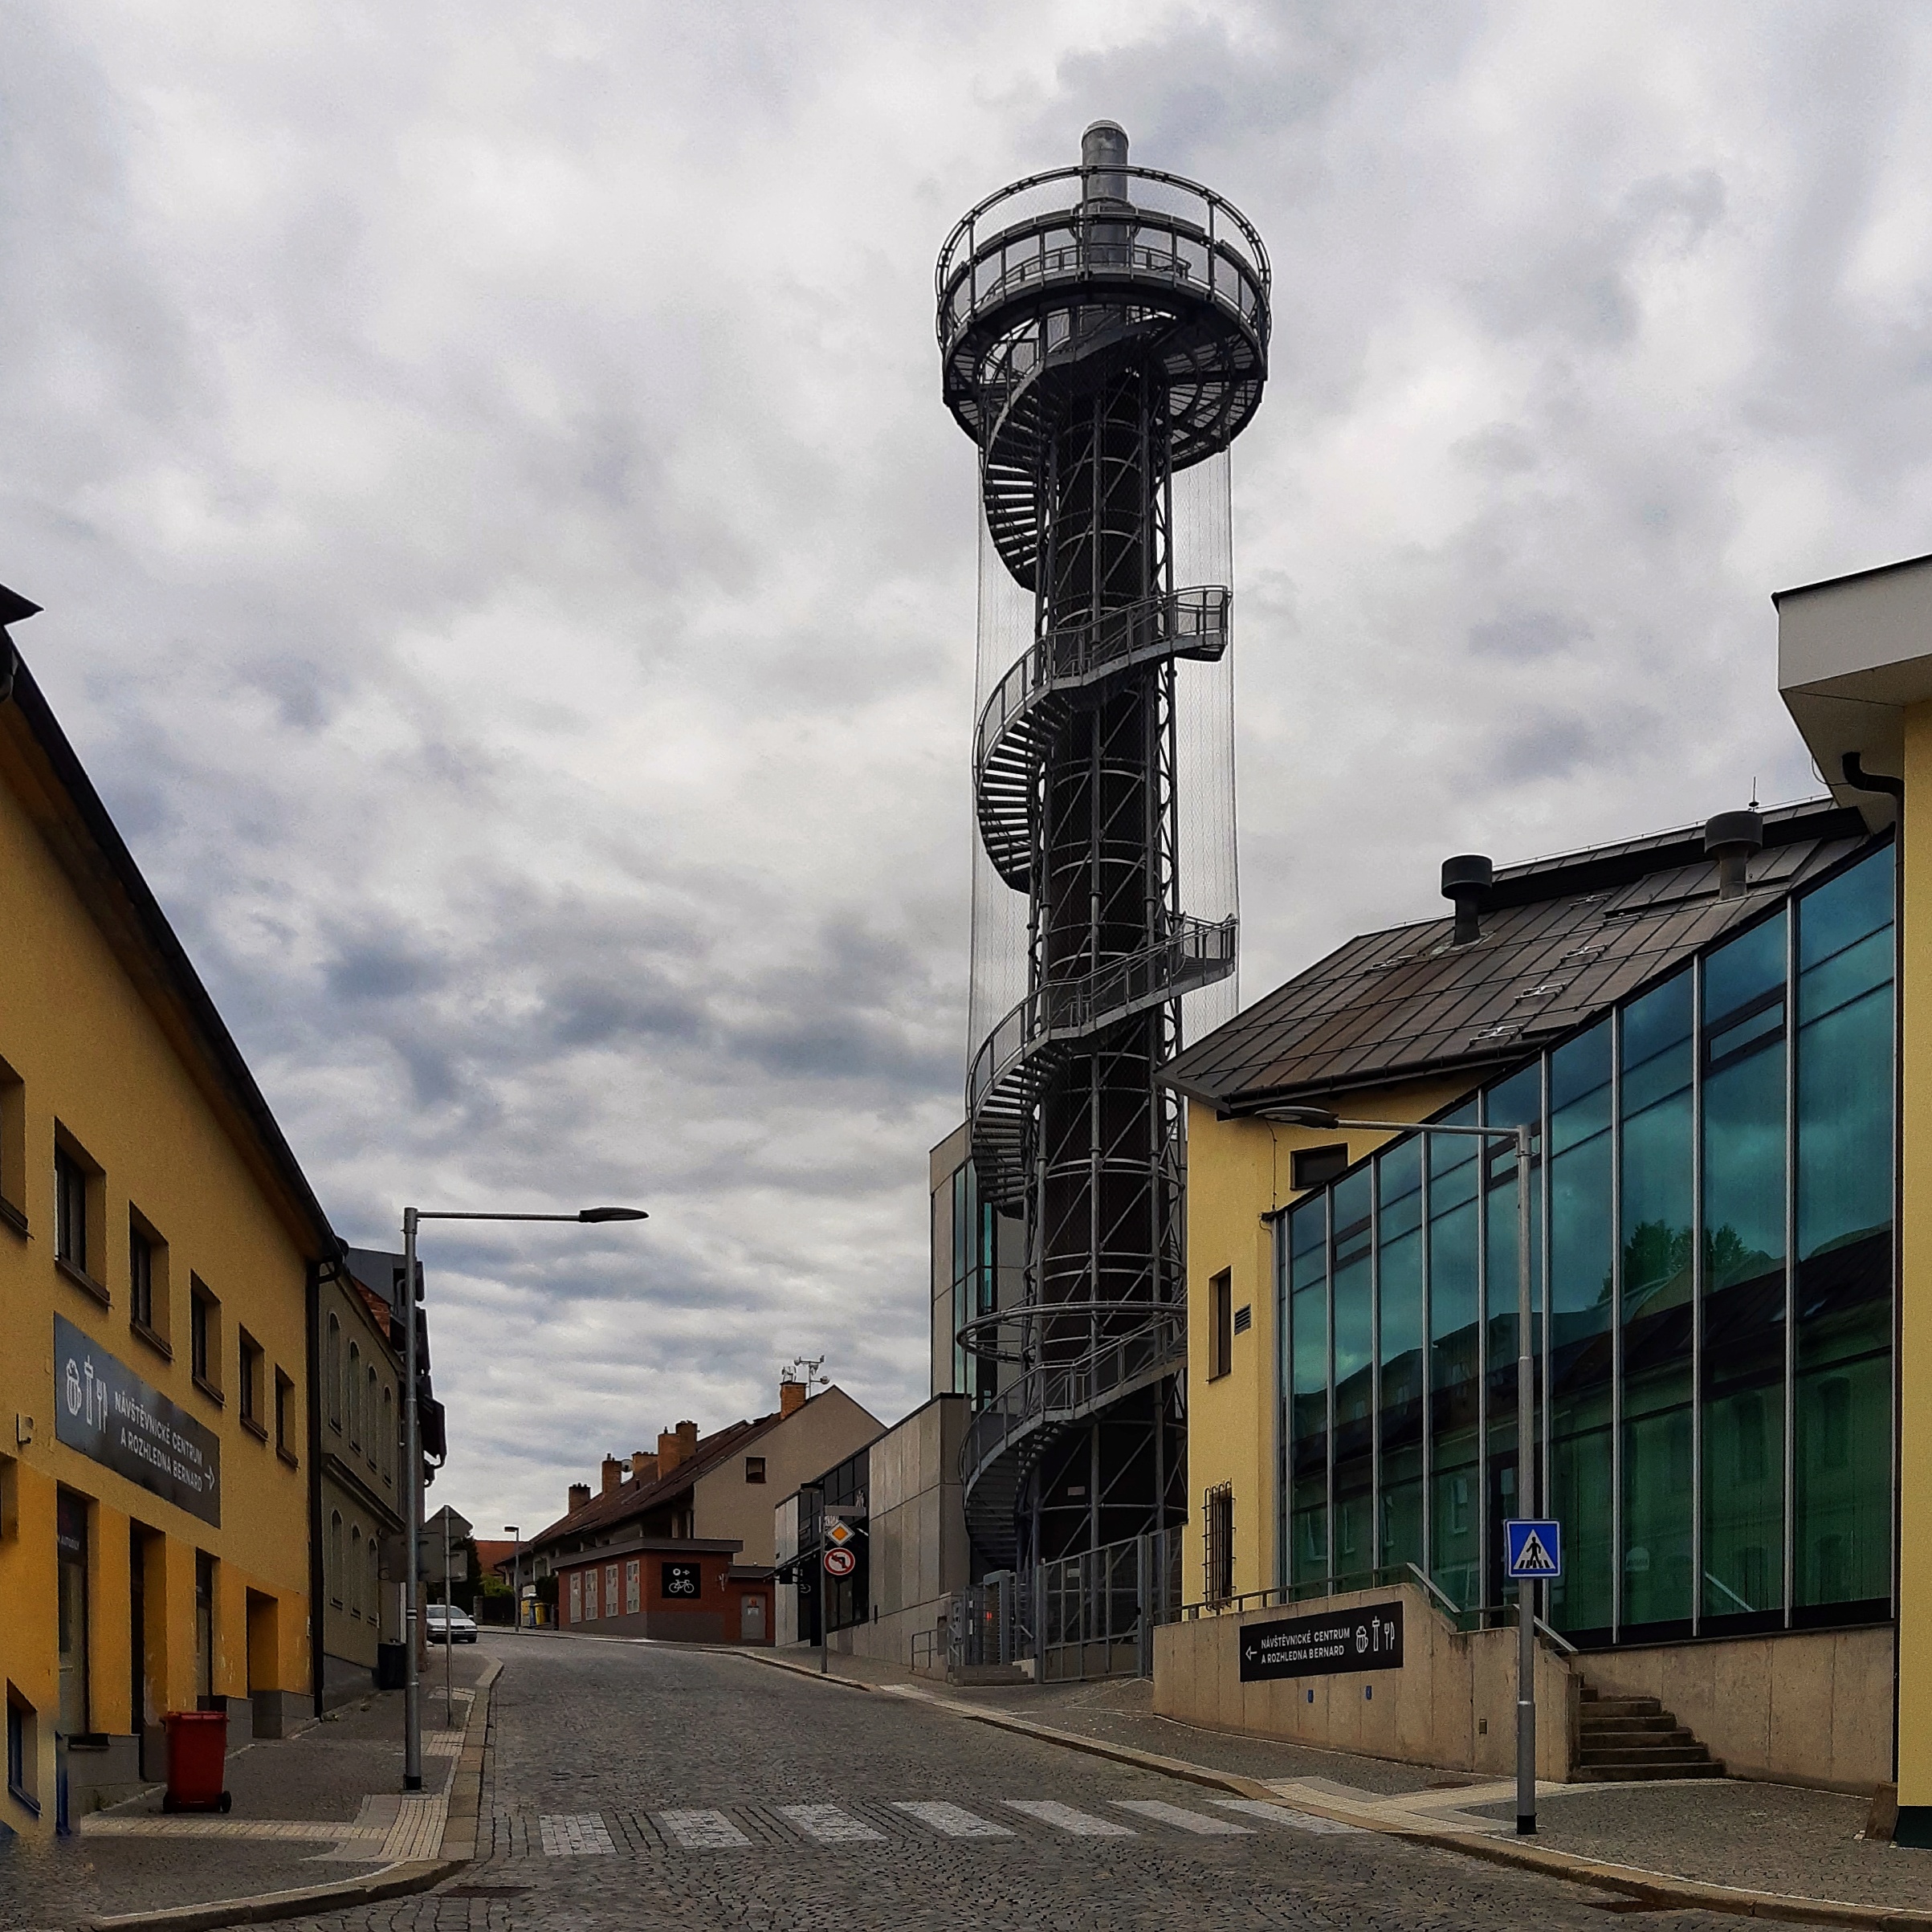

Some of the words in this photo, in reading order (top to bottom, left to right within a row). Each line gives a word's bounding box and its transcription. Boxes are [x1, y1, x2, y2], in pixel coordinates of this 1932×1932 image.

[115, 1391, 170, 1445] NÁVŠTĚVNICKÉ
[172, 1432, 202, 1468] CENTRUM
[120, 1427, 127, 1447] A
[128, 1430, 172, 1474] ROZHLEDNA
[173, 1460, 203, 1492] BERNARD
[1261, 1629, 1311, 1649] NÁVŠTĚVNICKÉ
[1314, 1627, 1351, 1642] CENTRUM
[1261, 1654, 1266, 1664] A
[1267, 1649, 1307, 1664] ROZHLEDNA
[1309, 1645, 1344, 1659] BERNARD
